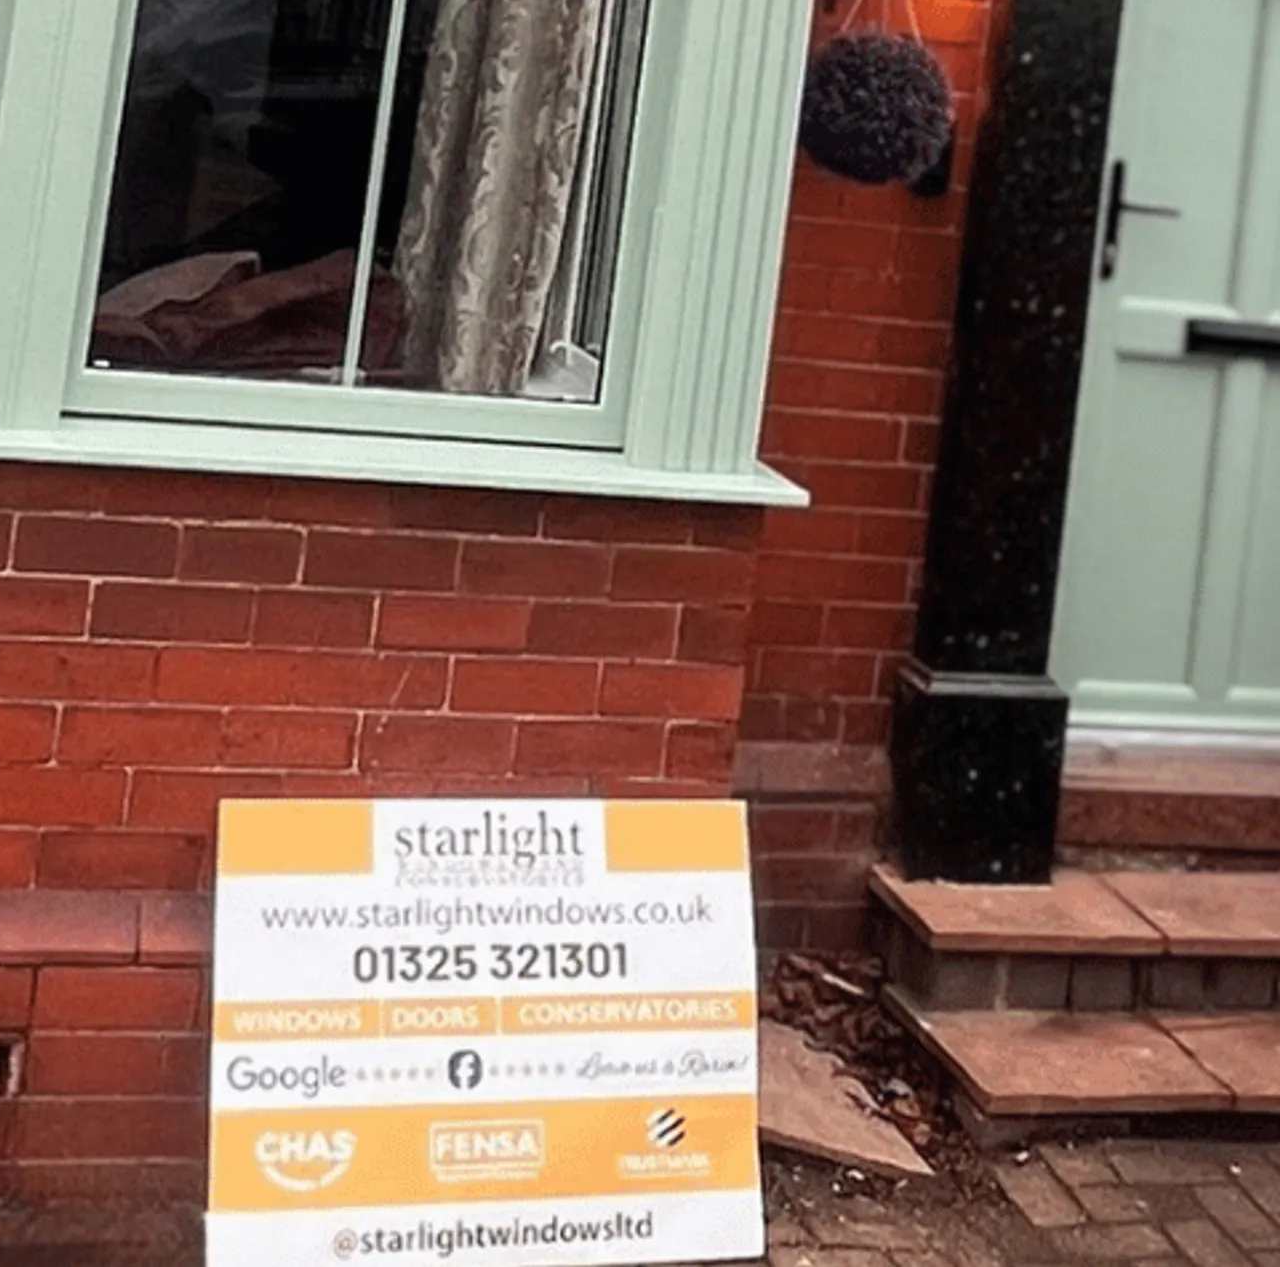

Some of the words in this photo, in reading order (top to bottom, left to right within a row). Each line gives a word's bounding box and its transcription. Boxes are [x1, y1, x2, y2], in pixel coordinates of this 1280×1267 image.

[394, 809, 585, 868] starlight
[260, 895, 714, 934] www.starlightwindows.co.uk
[352, 944, 478, 983] 01325
[488, 941, 629, 980] 321301
[232, 1006, 362, 1033] WINDOWS
[391, 1005, 479, 1030] DOORS
[519, 997, 737, 1026] CONSERVATORIES
[225, 1053, 347, 1099] Google
[254, 1130, 357, 1163] CHAS
[435, 1130, 539, 1161] FENSA
[332, 1211, 654, 1259] @starlightwindowsltd
